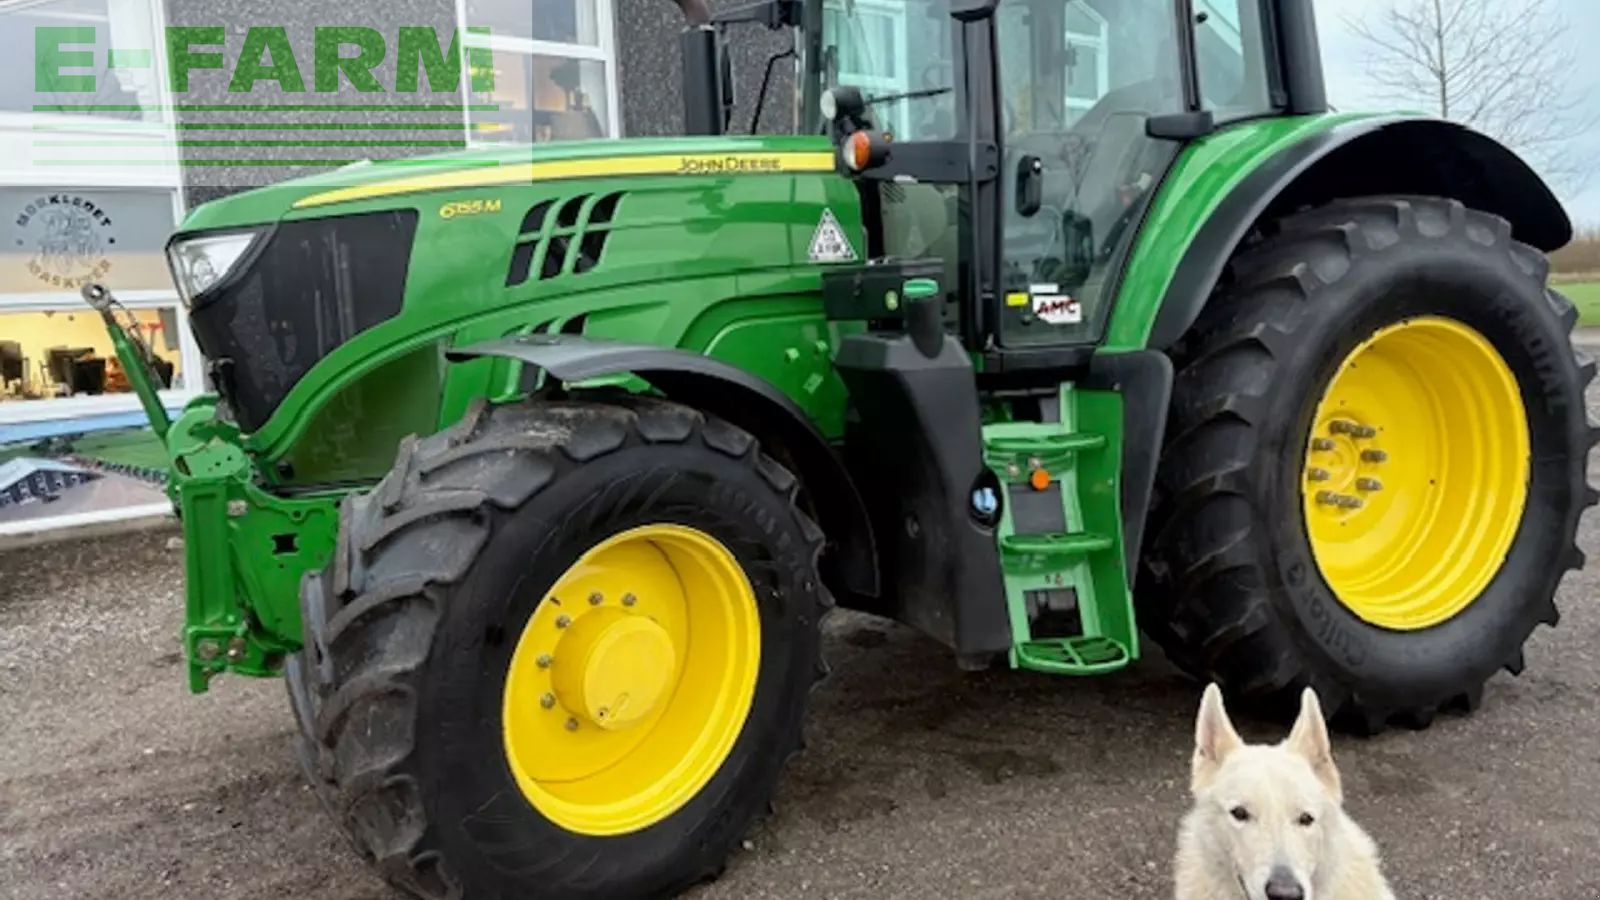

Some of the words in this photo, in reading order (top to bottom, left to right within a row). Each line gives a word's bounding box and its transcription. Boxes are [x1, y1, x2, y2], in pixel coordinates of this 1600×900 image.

[677, 156, 724, 171] JOHN
[726, 156, 781, 170] DEERE
[1034, 299, 1077, 317] AMC
